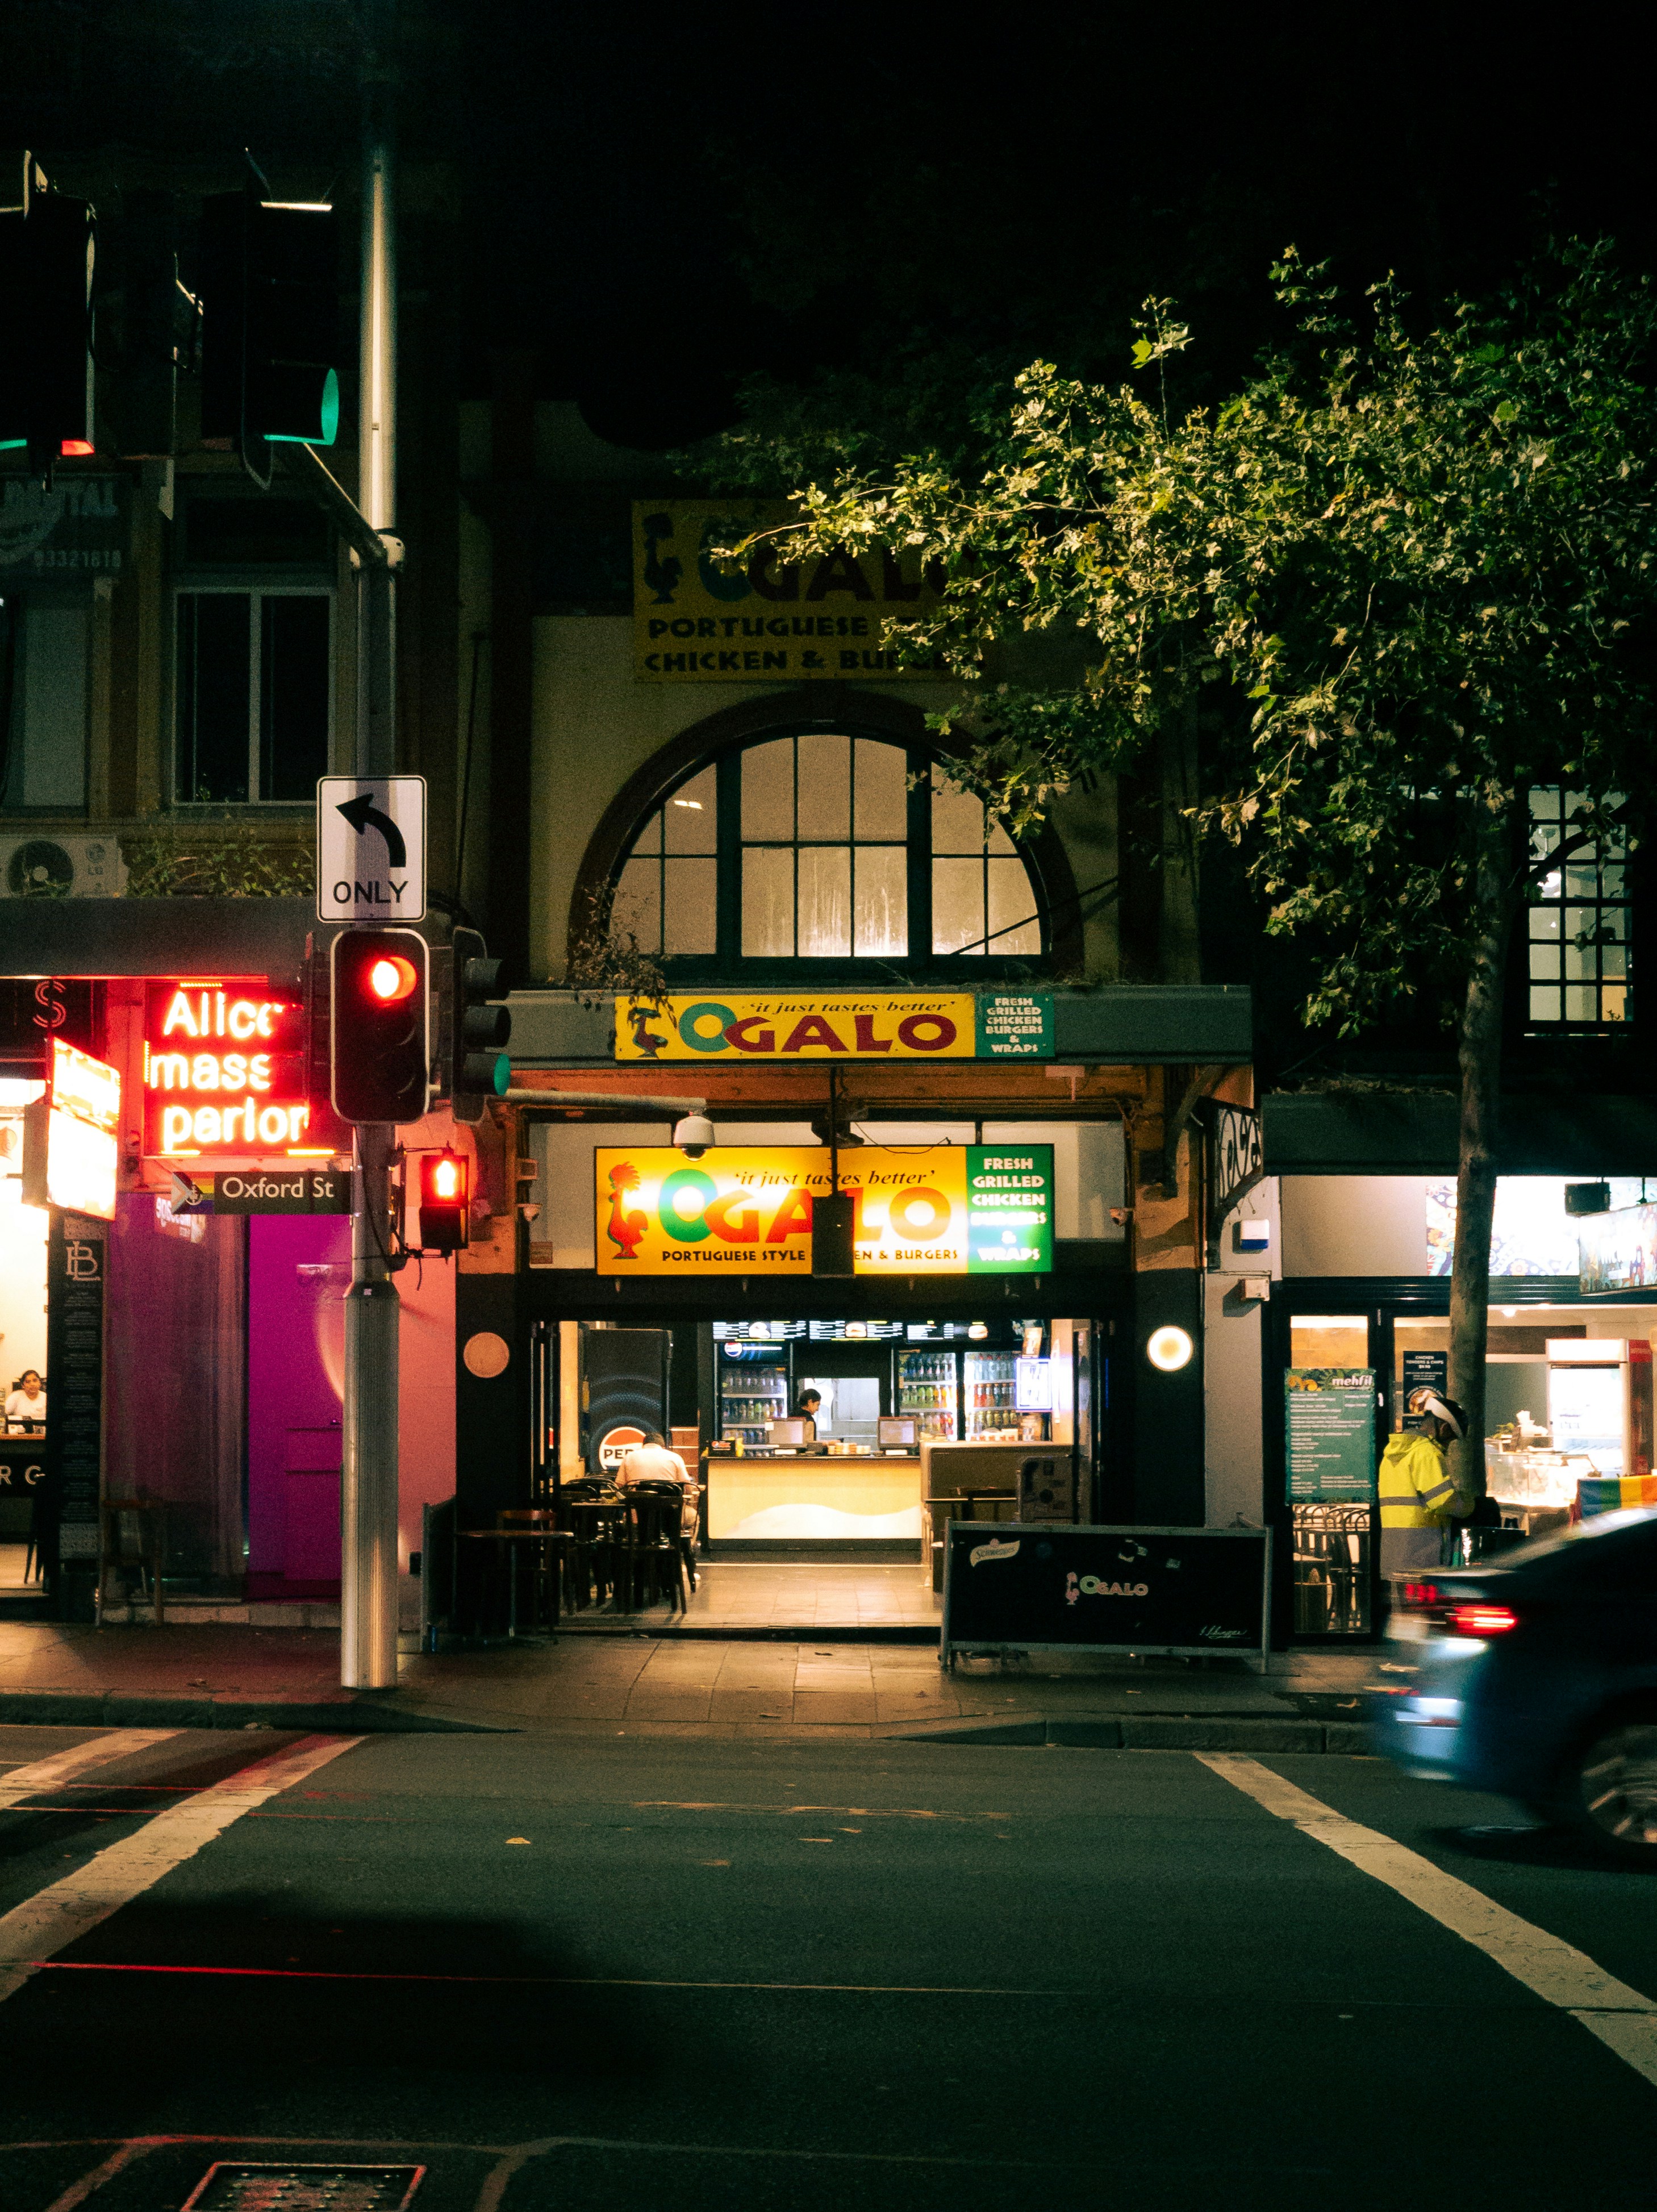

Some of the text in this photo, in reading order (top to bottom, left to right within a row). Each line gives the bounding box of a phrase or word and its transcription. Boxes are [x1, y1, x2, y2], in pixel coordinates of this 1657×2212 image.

[649, 616, 869, 639] PORTUGUESE
[645, 650, 787, 671] CHICKEN
[801, 650, 825, 669] &
[333, 880, 408, 904] ONLY
[772, 1002, 815, 1015] just
[821, 1002, 878, 1012] tastes
[995, 998, 1033, 1006] FRESH
[987, 1007, 1042, 1015] GRILLED
[987, 1016, 1042, 1025] CHICKEN
[985, 1025, 1043, 1034] BURGERS
[991, 1044, 1038, 1053] WRAPS
[164, 1096, 309, 1150] parlor
[983, 1158, 1033, 1170] FRESH
[757, 1171, 799, 1188] just
[972, 1175, 1045, 1188] GRILLED
[223, 1177, 334, 1198] Oxford St
[971, 1193, 1046, 1206] CHICKEN
[662, 1250, 756, 1261] PORTUGUESE
[762, 1250, 805, 1261] STYLE
[879, 1250, 888, 1259] &
[895, 1250, 958, 1259] BURGERS
[977, 1247, 1040, 1261] WRAPS
[1332, 1375, 1372, 1386] mehfil
